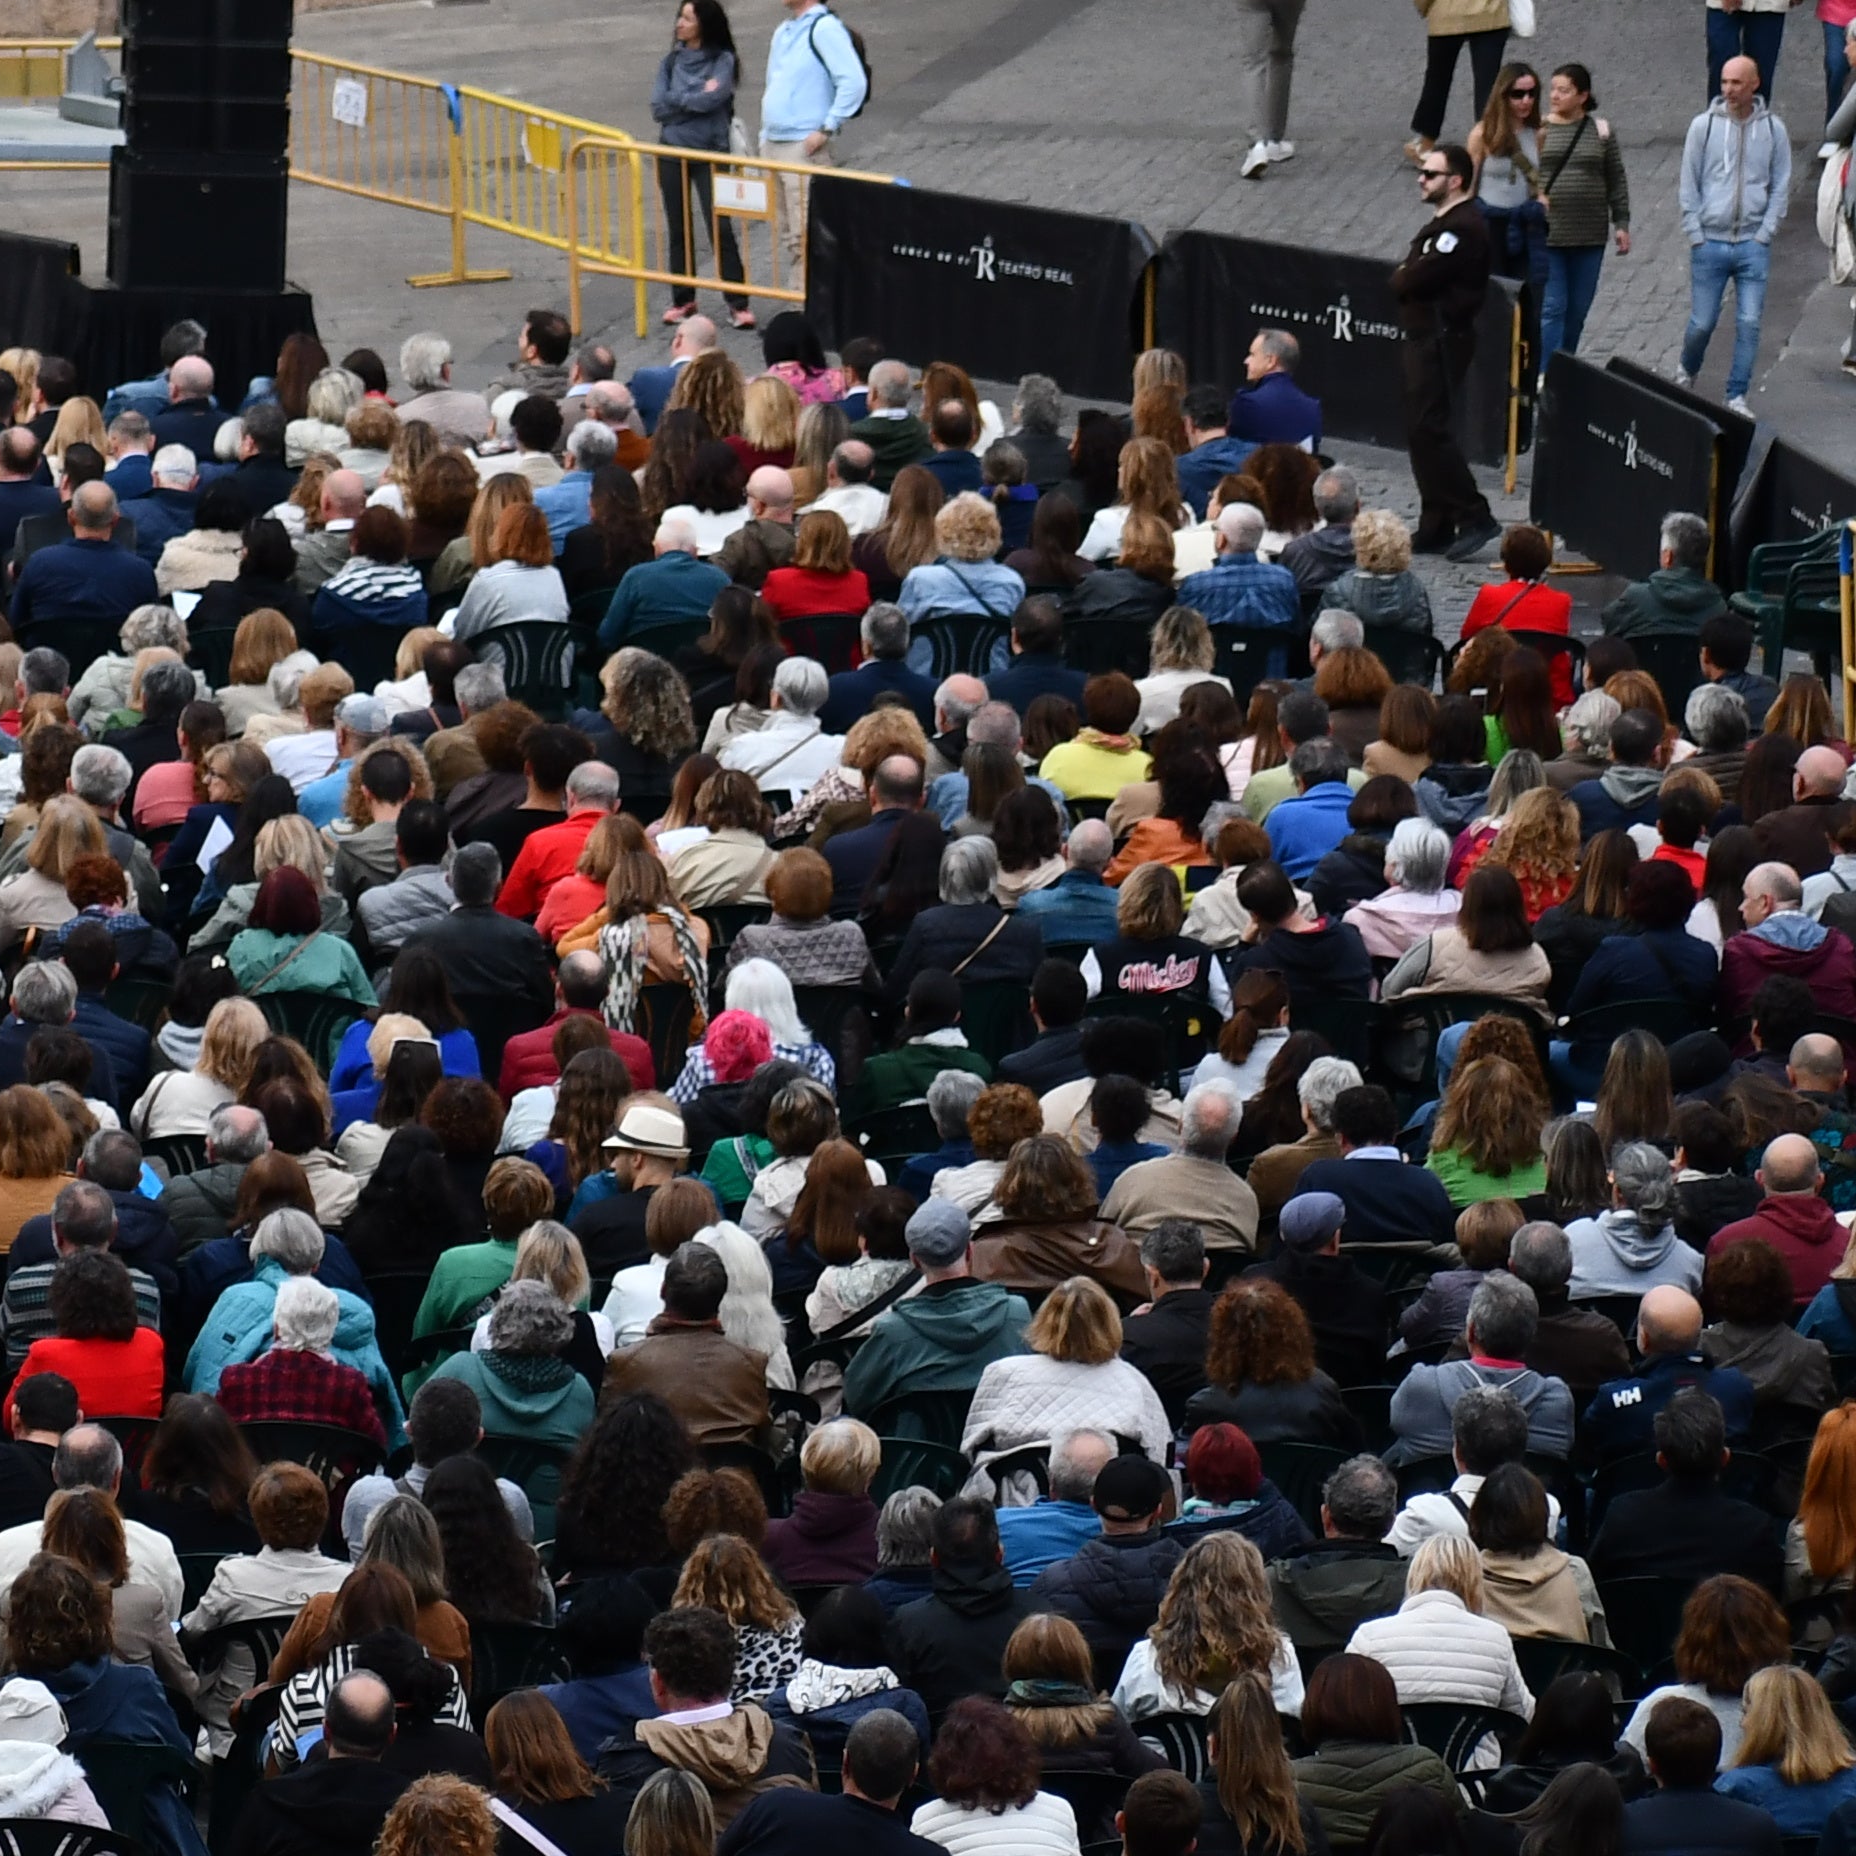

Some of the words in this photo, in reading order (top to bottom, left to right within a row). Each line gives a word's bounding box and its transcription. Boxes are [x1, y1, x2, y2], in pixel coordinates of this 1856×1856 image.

[997, 259, 1043, 280] TEATRO
[1044, 266, 1074, 286] REAL
[1354, 318, 1400, 341] TEATRO
[1612, 1386, 1642, 1409] HH
